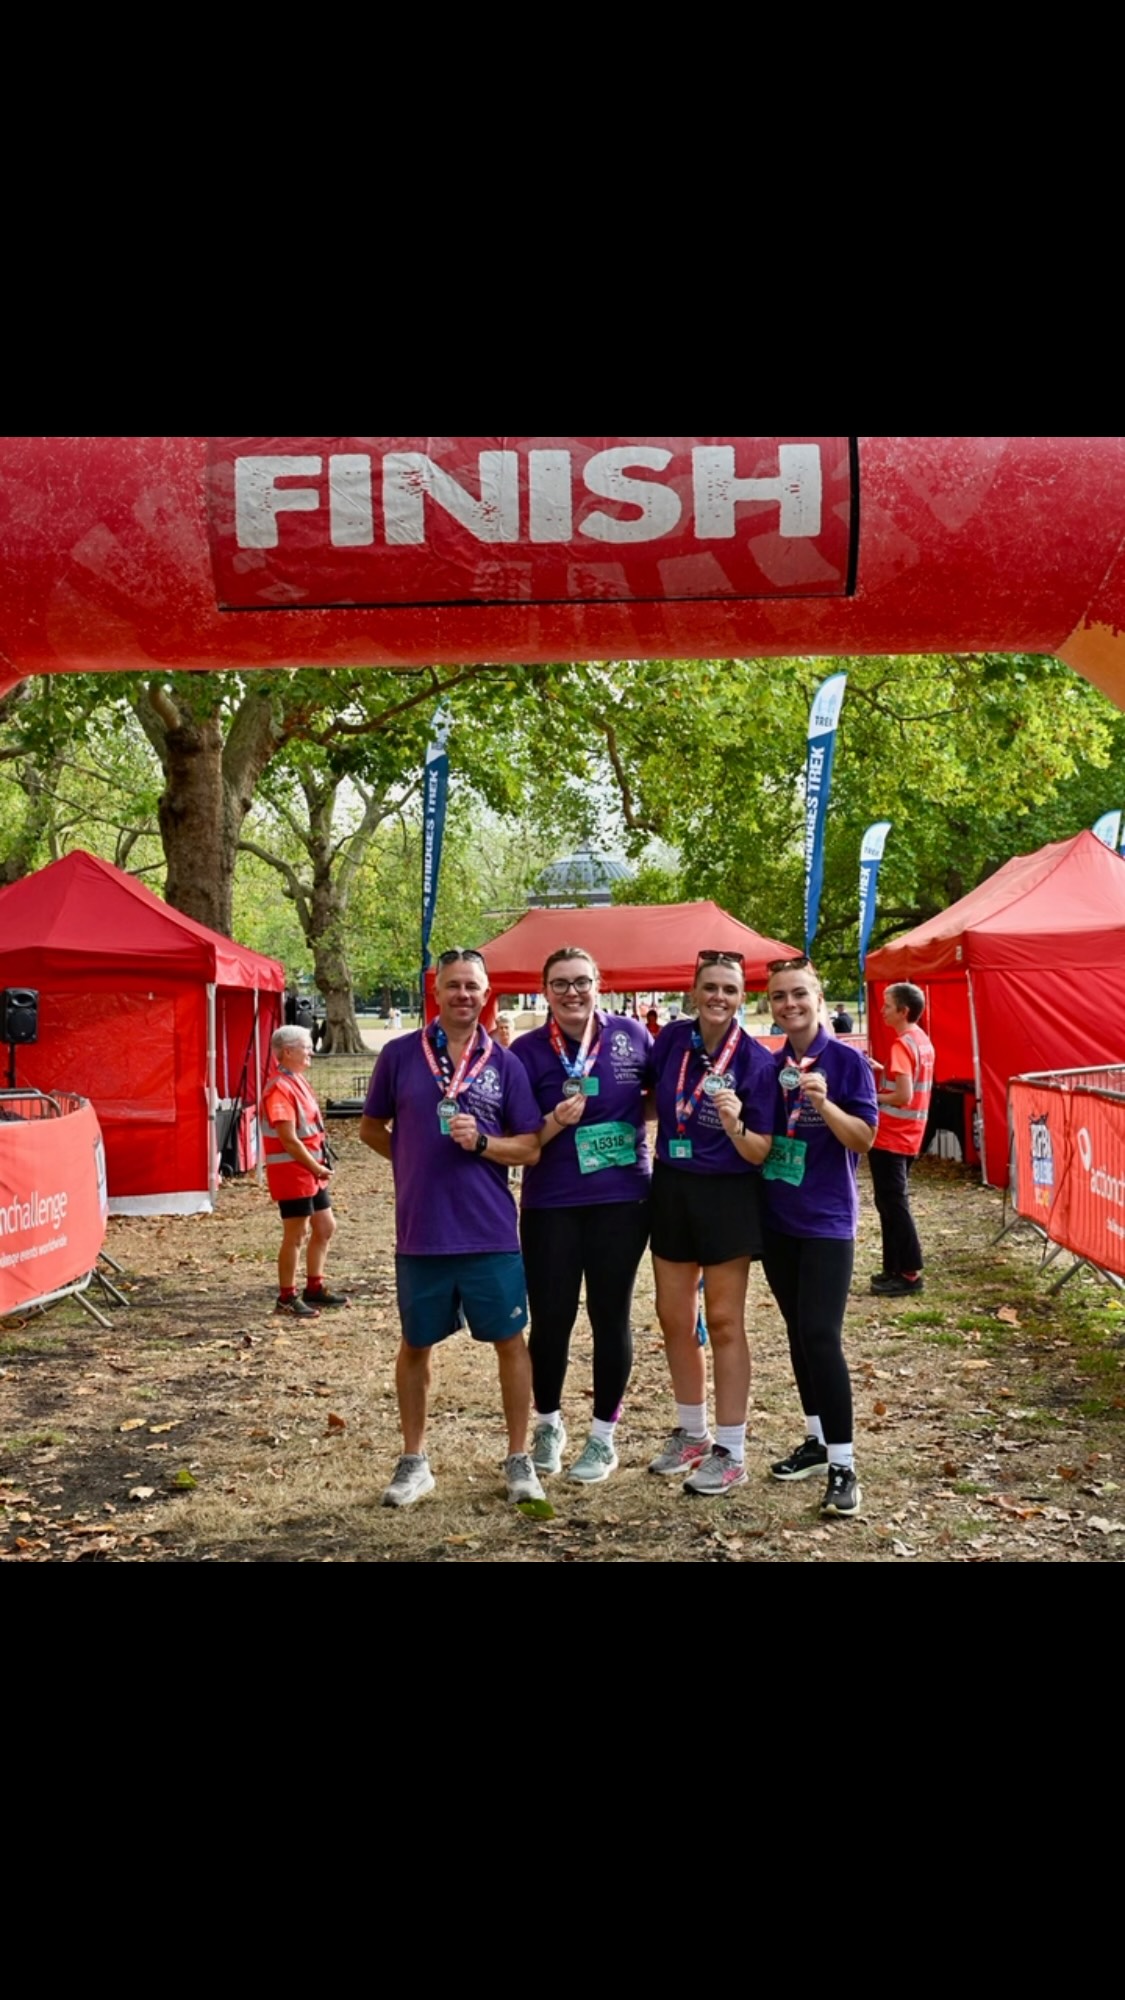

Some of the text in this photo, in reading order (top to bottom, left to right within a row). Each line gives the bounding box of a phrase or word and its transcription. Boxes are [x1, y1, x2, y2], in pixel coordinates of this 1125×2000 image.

[234, 444, 822, 549] FINISH
[808, 745, 826, 791] TREK
[428, 769, 439, 814] TREK
[593, 1135, 624, 1151] 15318
